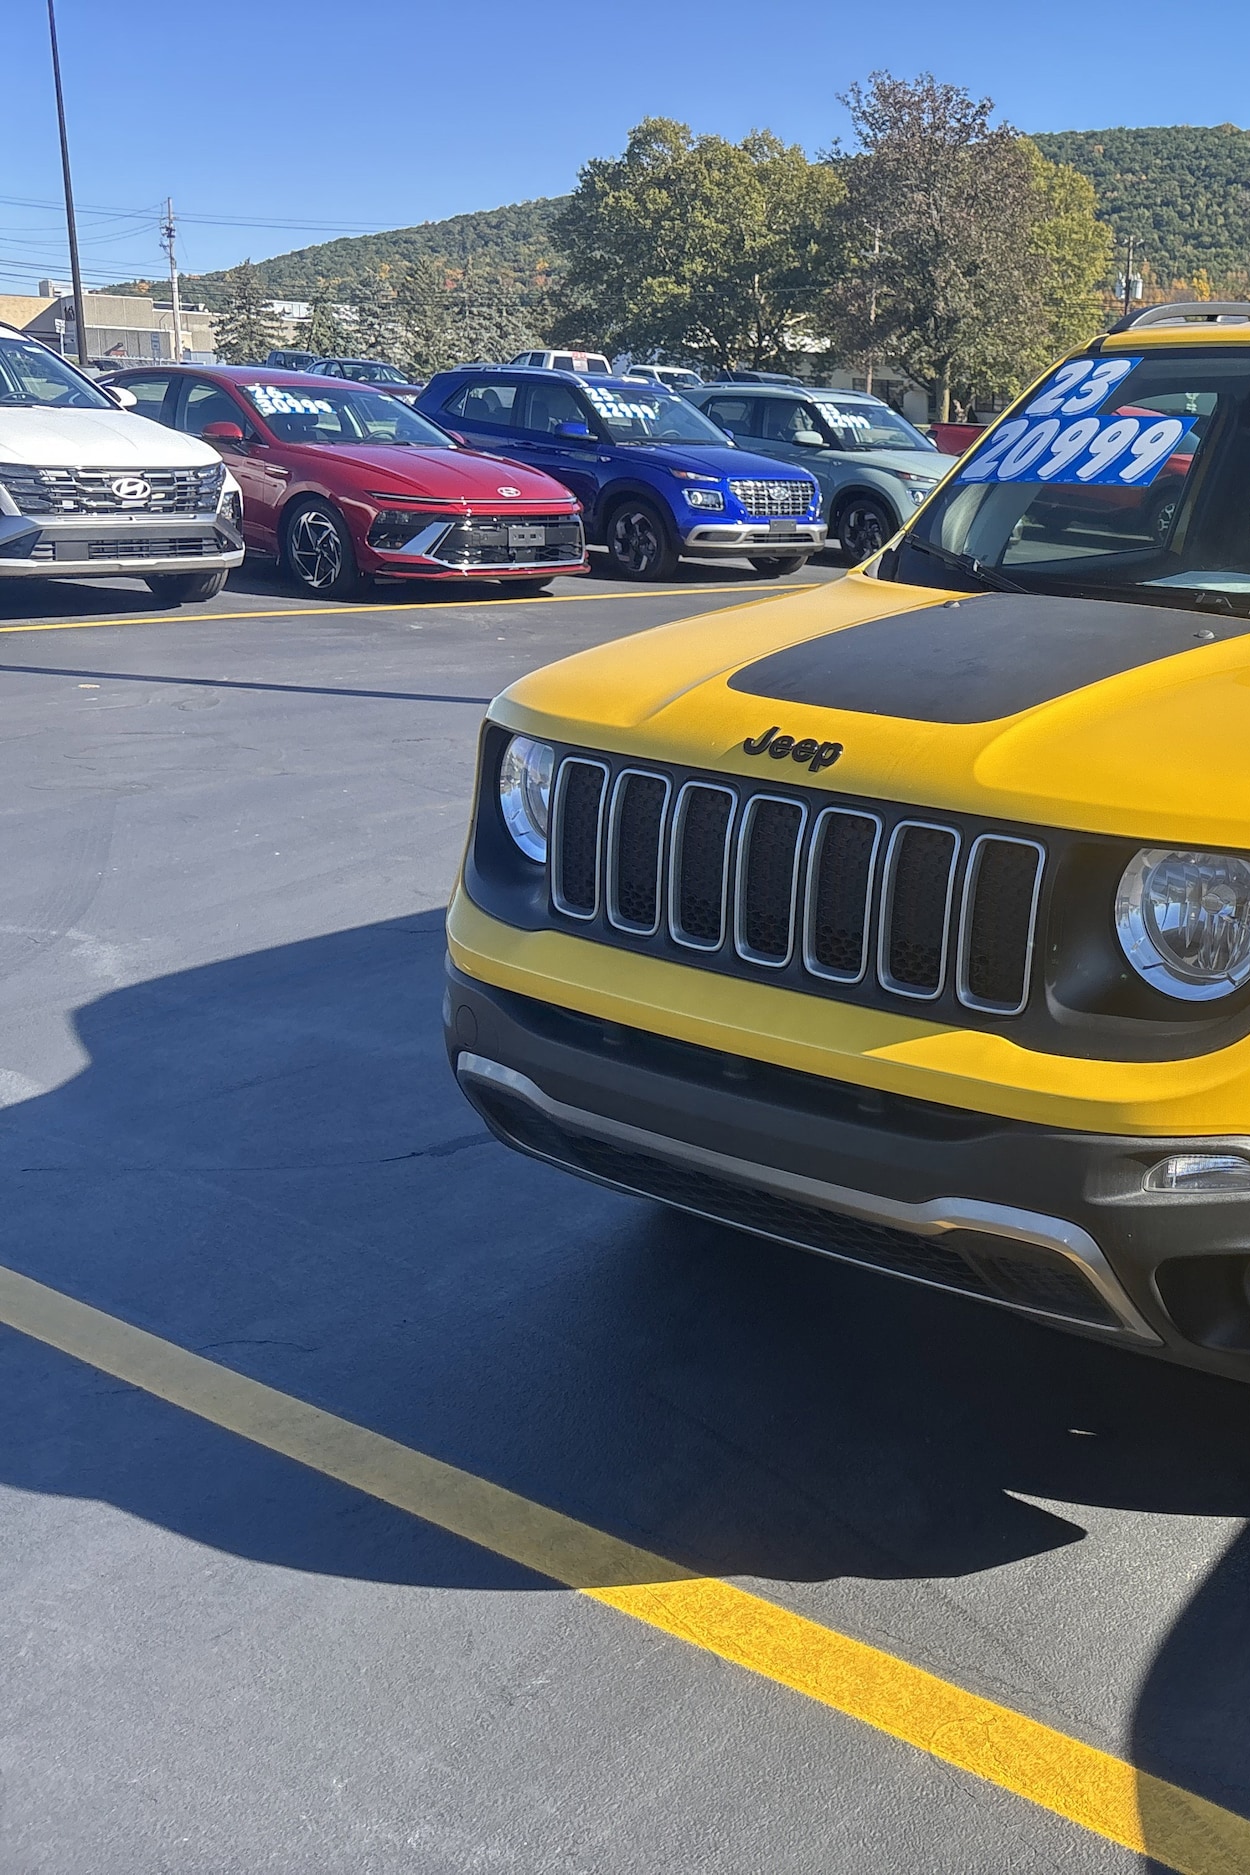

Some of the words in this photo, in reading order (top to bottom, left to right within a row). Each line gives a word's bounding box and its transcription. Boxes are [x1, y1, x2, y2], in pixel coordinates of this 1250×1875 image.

[256, 398, 332, 414] 30999
[593, 402, 656, 420] 22999
[1024, 360, 1131, 416] 23
[961, 418, 1183, 482] 20999
[743, 726, 844, 772] Jeep
